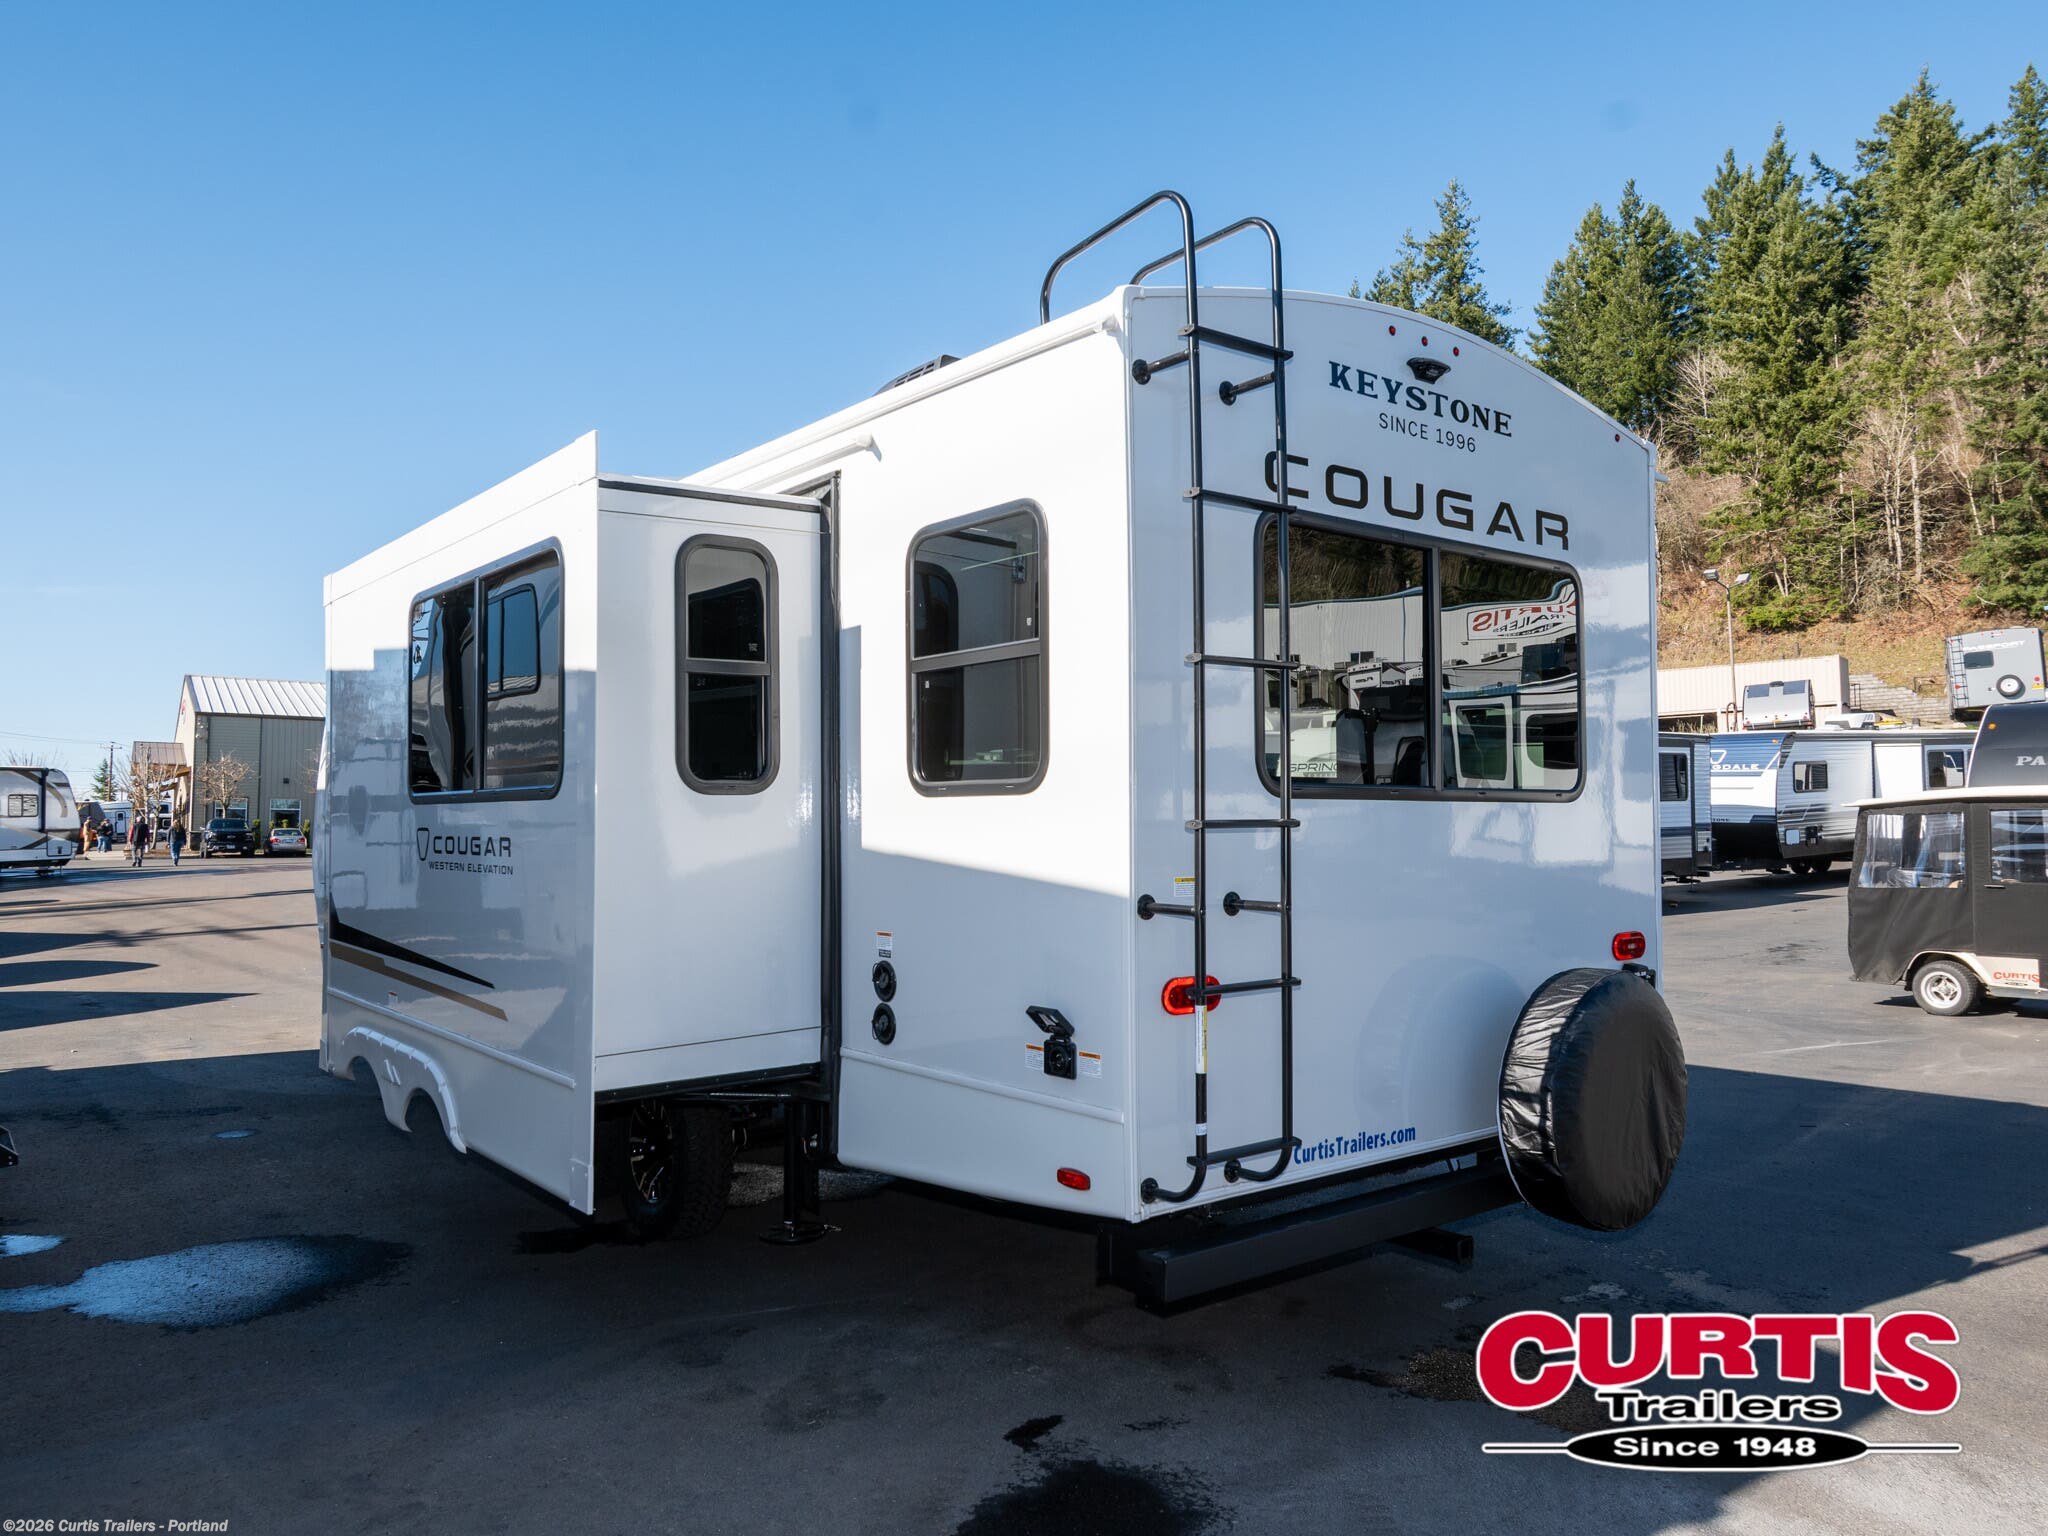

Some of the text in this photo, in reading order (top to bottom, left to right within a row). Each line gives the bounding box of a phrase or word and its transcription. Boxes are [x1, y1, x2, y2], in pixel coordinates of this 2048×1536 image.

[1328, 360, 1512, 438] KEYSTONE
[1378, 412, 1477, 453] SINCE 1996
[1264, 450, 1569, 551] COUGAR
[2015, 755, 2047, 766] PA
[433, 835, 512, 858] COUGAR
[428, 861, 513, 875] WESTERN ELEVATION
[1993, 971, 2040, 983] CURTIS
[1293, 1126, 1416, 1165] CurtisTrailers.com
